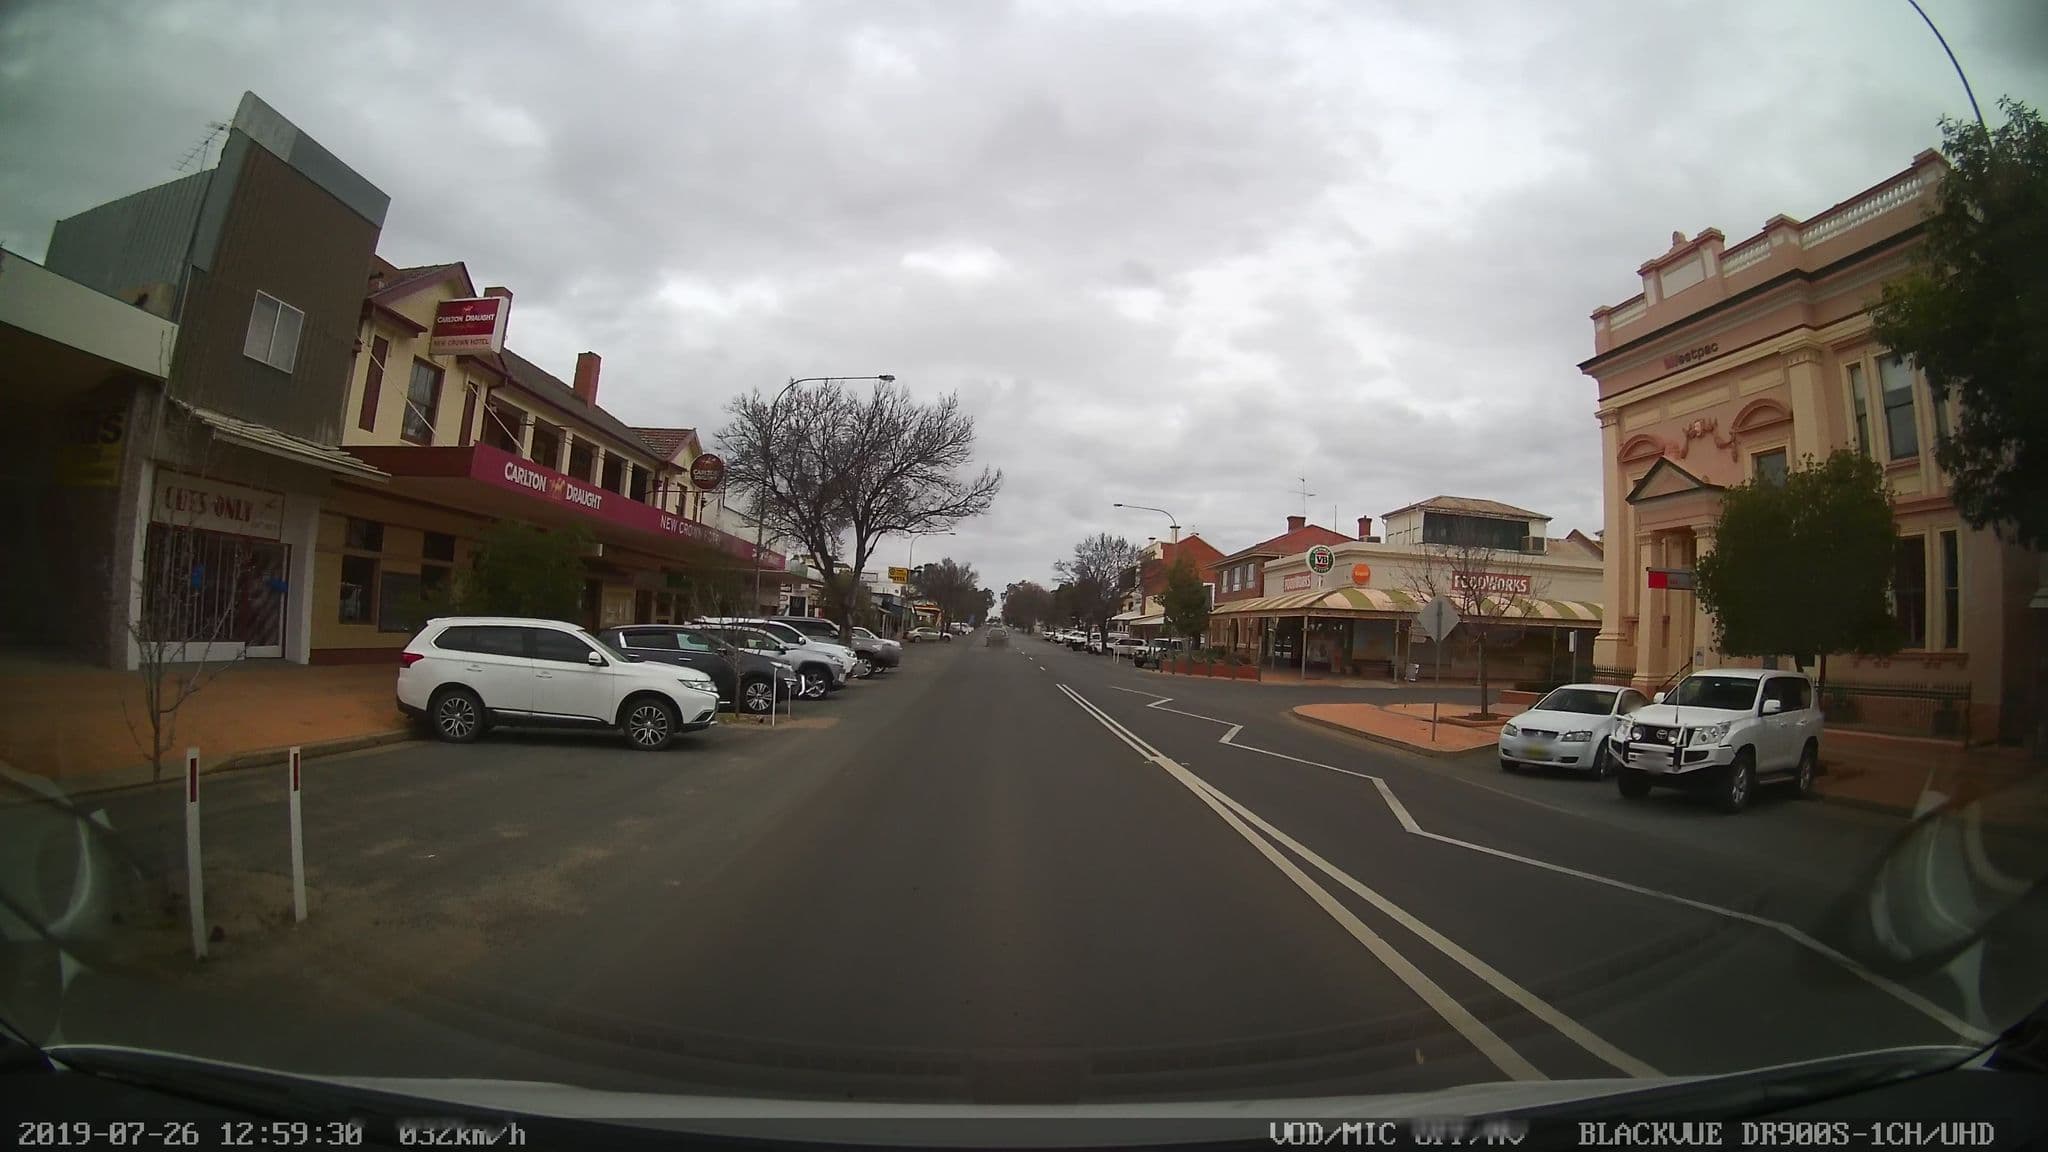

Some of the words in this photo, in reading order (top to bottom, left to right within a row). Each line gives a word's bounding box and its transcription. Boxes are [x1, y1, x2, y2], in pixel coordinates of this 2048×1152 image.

[437, 316, 464, 324] CARLTON
[465, 313, 496, 322] DRAUGHT
[504, 461, 547, 492] CARLTON
[565, 482, 602, 510] DRAUGHT
[659, 515, 678, 534] NEW
[1316, 555, 1329, 564] VB
